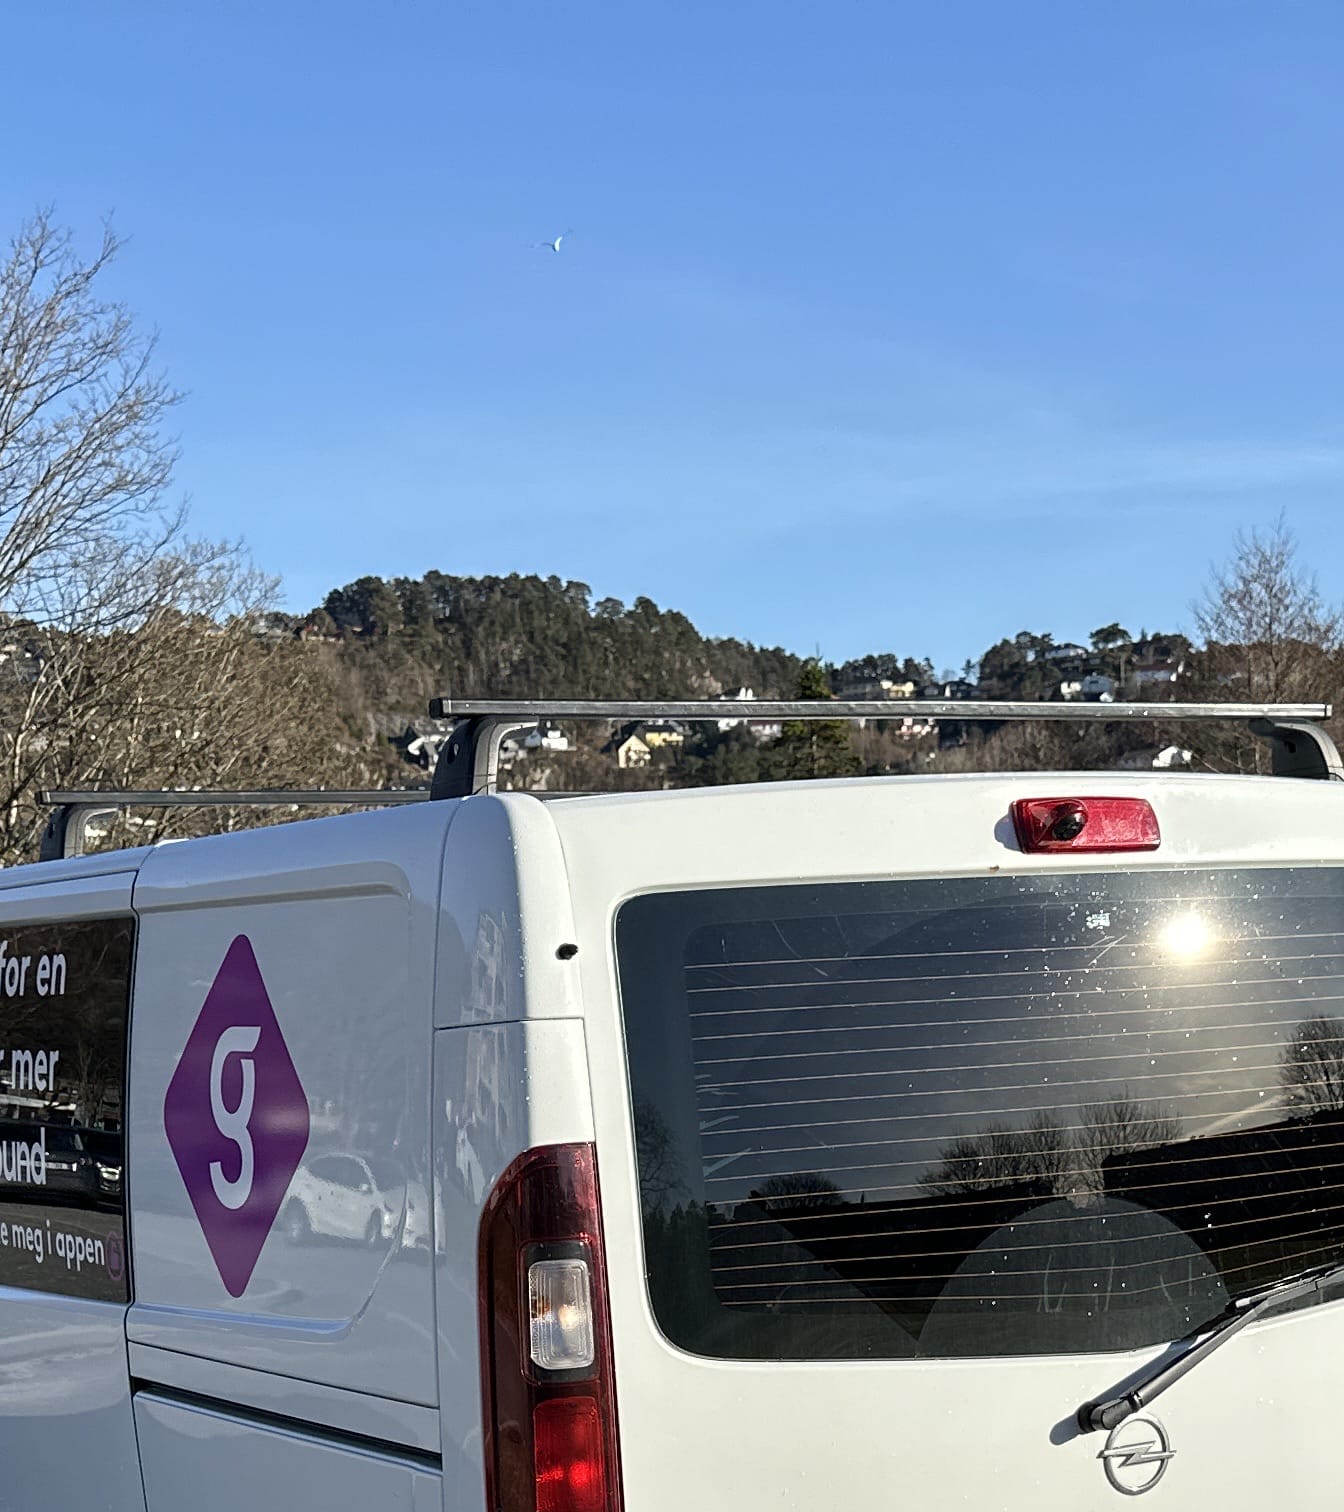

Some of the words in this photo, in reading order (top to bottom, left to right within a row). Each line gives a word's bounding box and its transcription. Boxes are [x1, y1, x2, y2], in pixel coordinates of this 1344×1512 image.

[36, 953, 66, 996] en
[11, 1049, 59, 1091] mer
[12, 1224, 43, 1263] meg
[46, 1219, 52, 1254] i
[55, 1231, 105, 1271] appen
